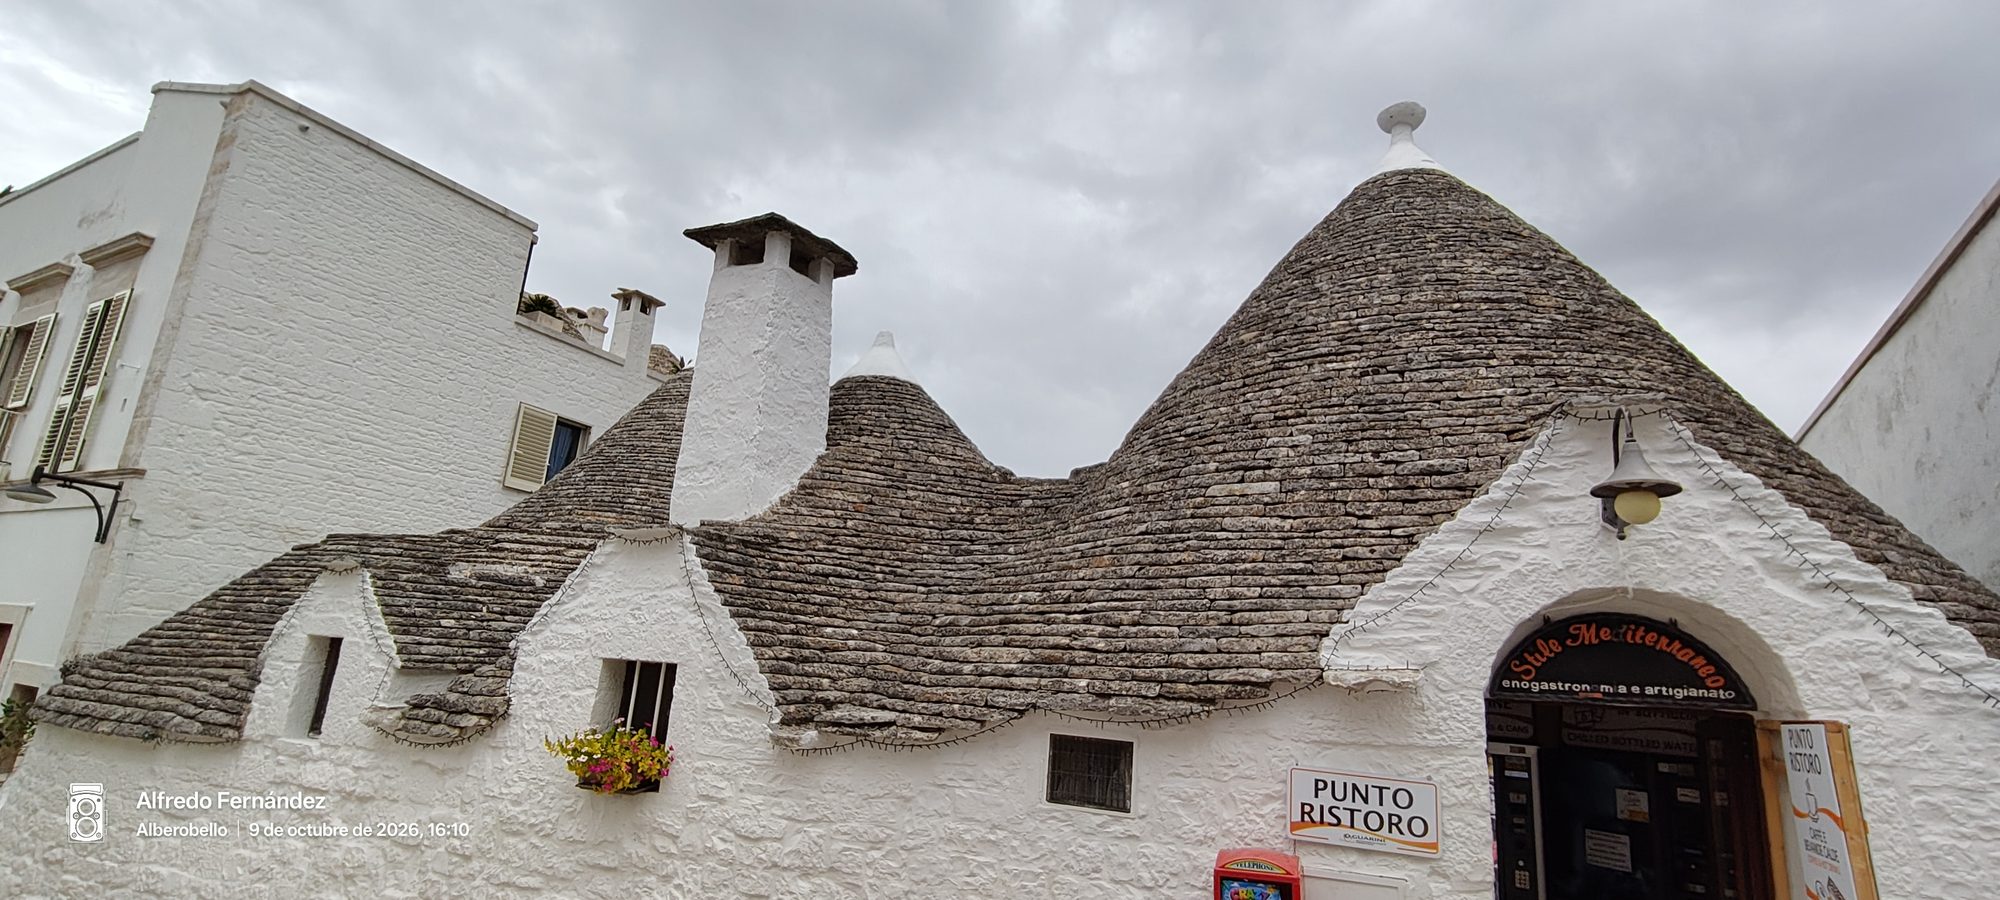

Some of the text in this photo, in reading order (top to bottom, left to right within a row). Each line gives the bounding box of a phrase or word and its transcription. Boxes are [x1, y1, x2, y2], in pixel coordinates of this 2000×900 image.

[1511, 623, 1726, 689] Stile Mediterraneo
[1502, 678, 1735, 699] enogastronomia e artigianato
[1612, 736, 1660, 749] BOTTLED
[1788, 728, 1814, 750] PUNTO
[1789, 752, 1822, 775] RISTORO
[1314, 778, 1414, 810] PUNTO
[1300, 802, 1429, 838] RISTORO
[1235, 861, 1274, 871] TELEPHONE
